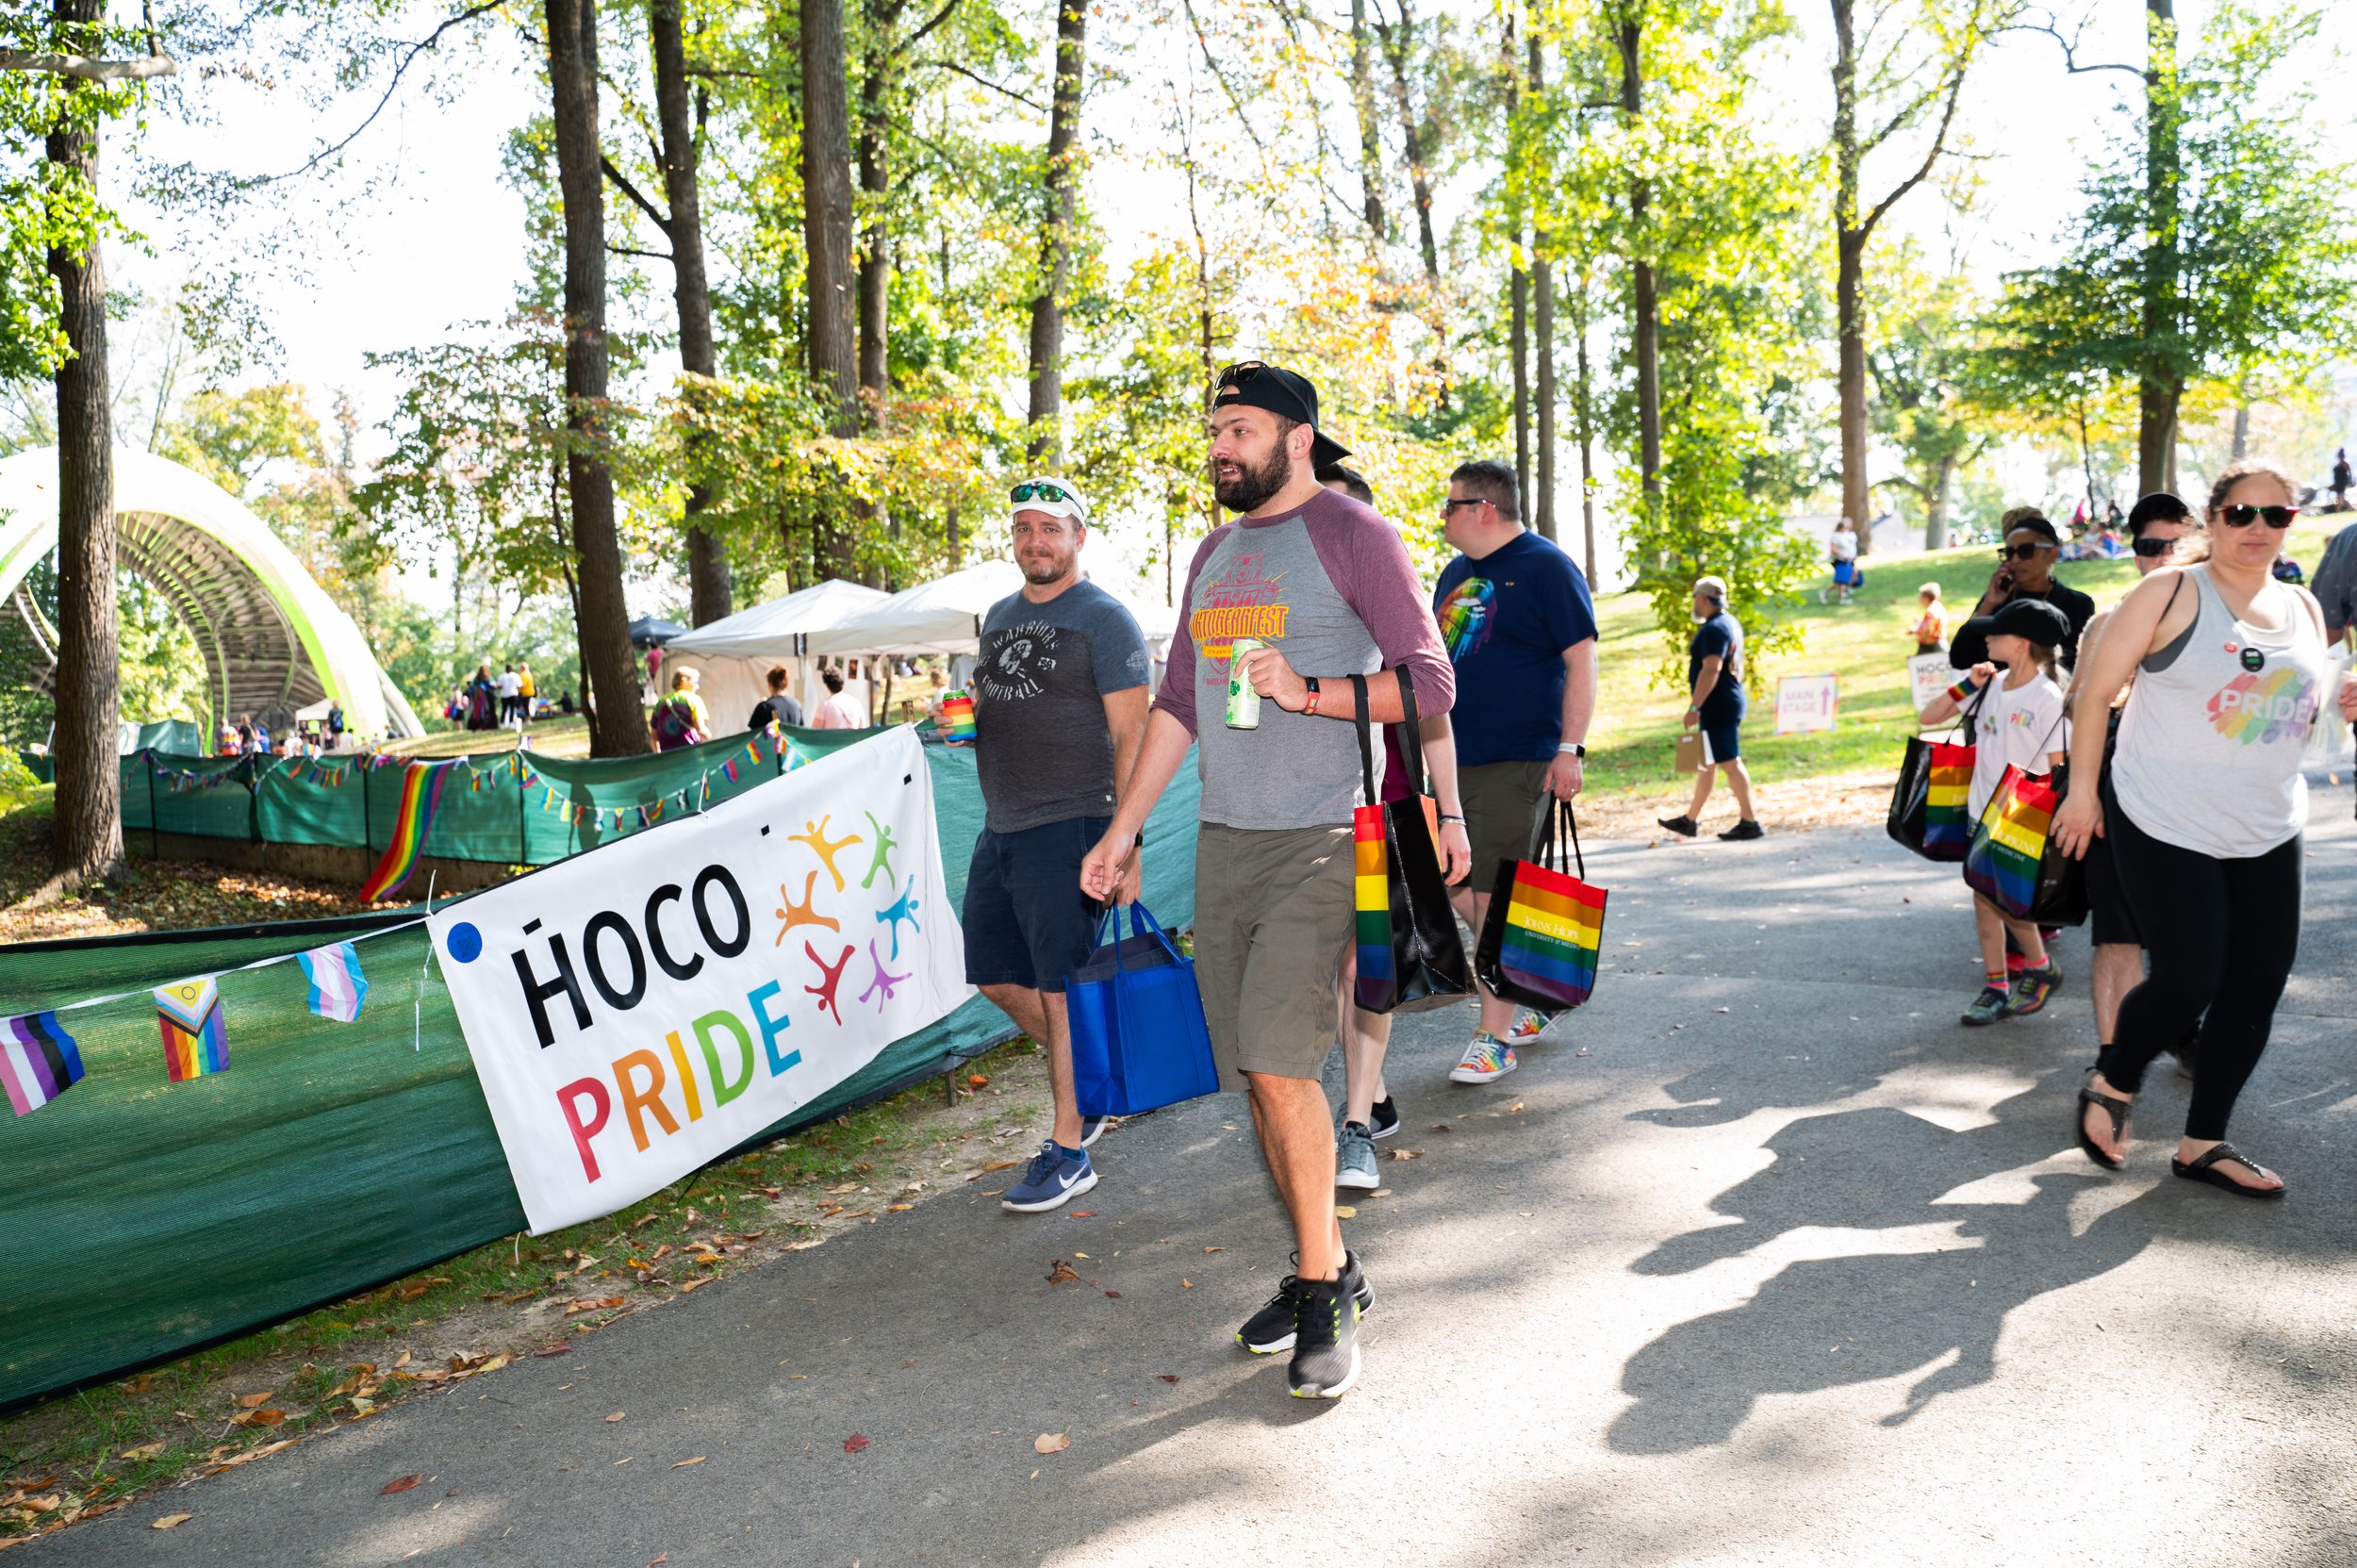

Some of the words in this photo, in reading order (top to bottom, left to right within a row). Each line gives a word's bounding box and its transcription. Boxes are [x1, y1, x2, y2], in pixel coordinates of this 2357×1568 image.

[1783, 702, 1817, 714] STAGE
[1786, 690, 1814, 701] MAIN
[2219, 689, 2310, 722] PRIDE
[1525, 916, 1551, 933] JOHNS
[510, 864, 751, 1048] HOCO
[555, 979, 802, 1183] PRIDE
